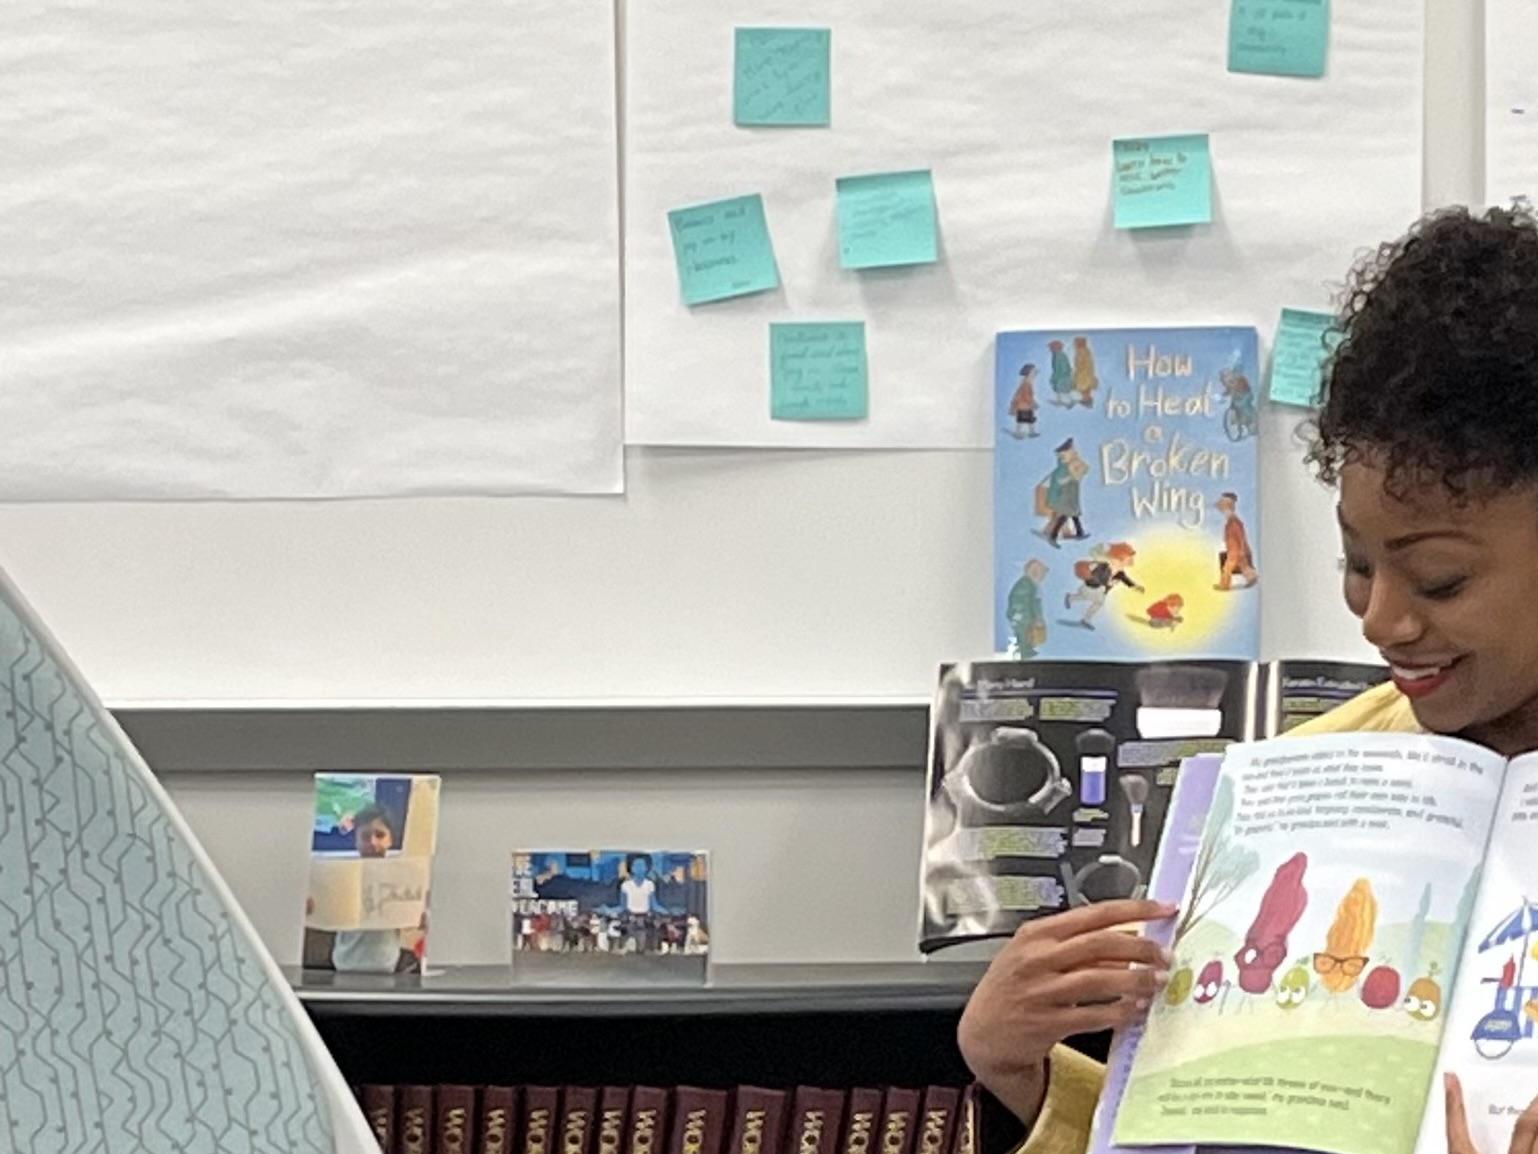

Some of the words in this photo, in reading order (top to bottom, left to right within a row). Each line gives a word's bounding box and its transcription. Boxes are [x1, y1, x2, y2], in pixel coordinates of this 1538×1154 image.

[1127, 344, 1193, 381] How
[1107, 387, 1132, 419] to
[1137, 382, 1215, 421] Heal
[1144, 423, 1164, 442] a
[1101, 433, 1231, 486] Broken
[1131, 480, 1205, 529] Wing
